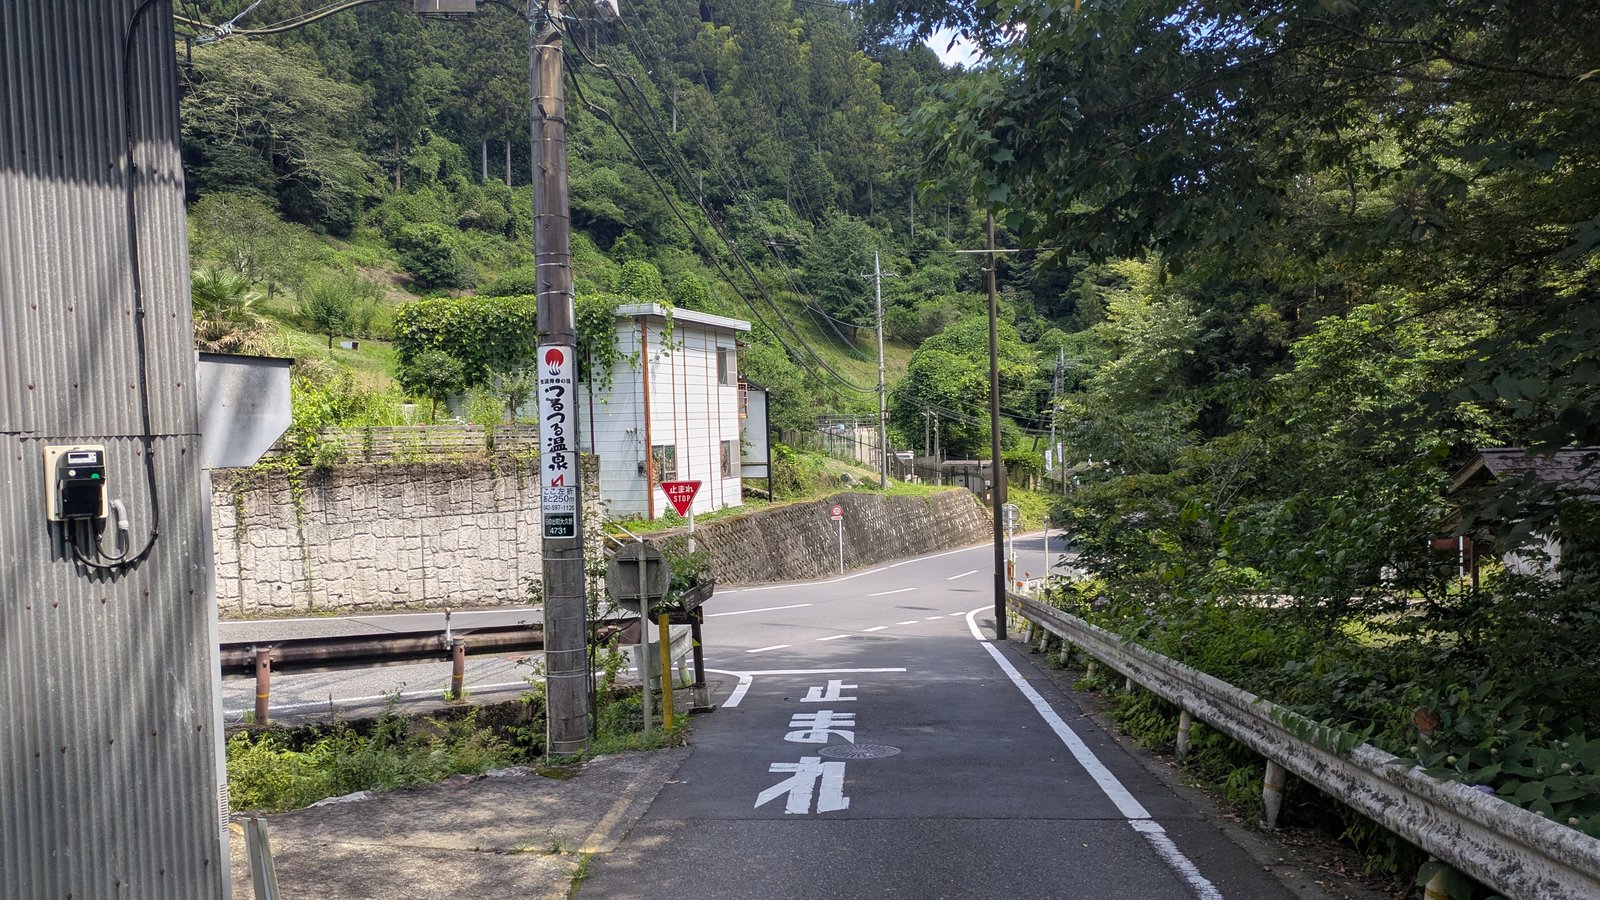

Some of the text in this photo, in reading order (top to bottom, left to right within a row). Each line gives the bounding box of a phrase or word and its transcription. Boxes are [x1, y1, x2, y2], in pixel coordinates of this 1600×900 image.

[544, 385, 569, 471] つるつる温泉
[543, 487, 574, 495] ここ左折
[669, 485, 694, 494] 止まれ
[543, 495, 575, 503] あと250m
[549, 527, 567, 535] 4731
[753, 679, 858, 814] 止まれ
